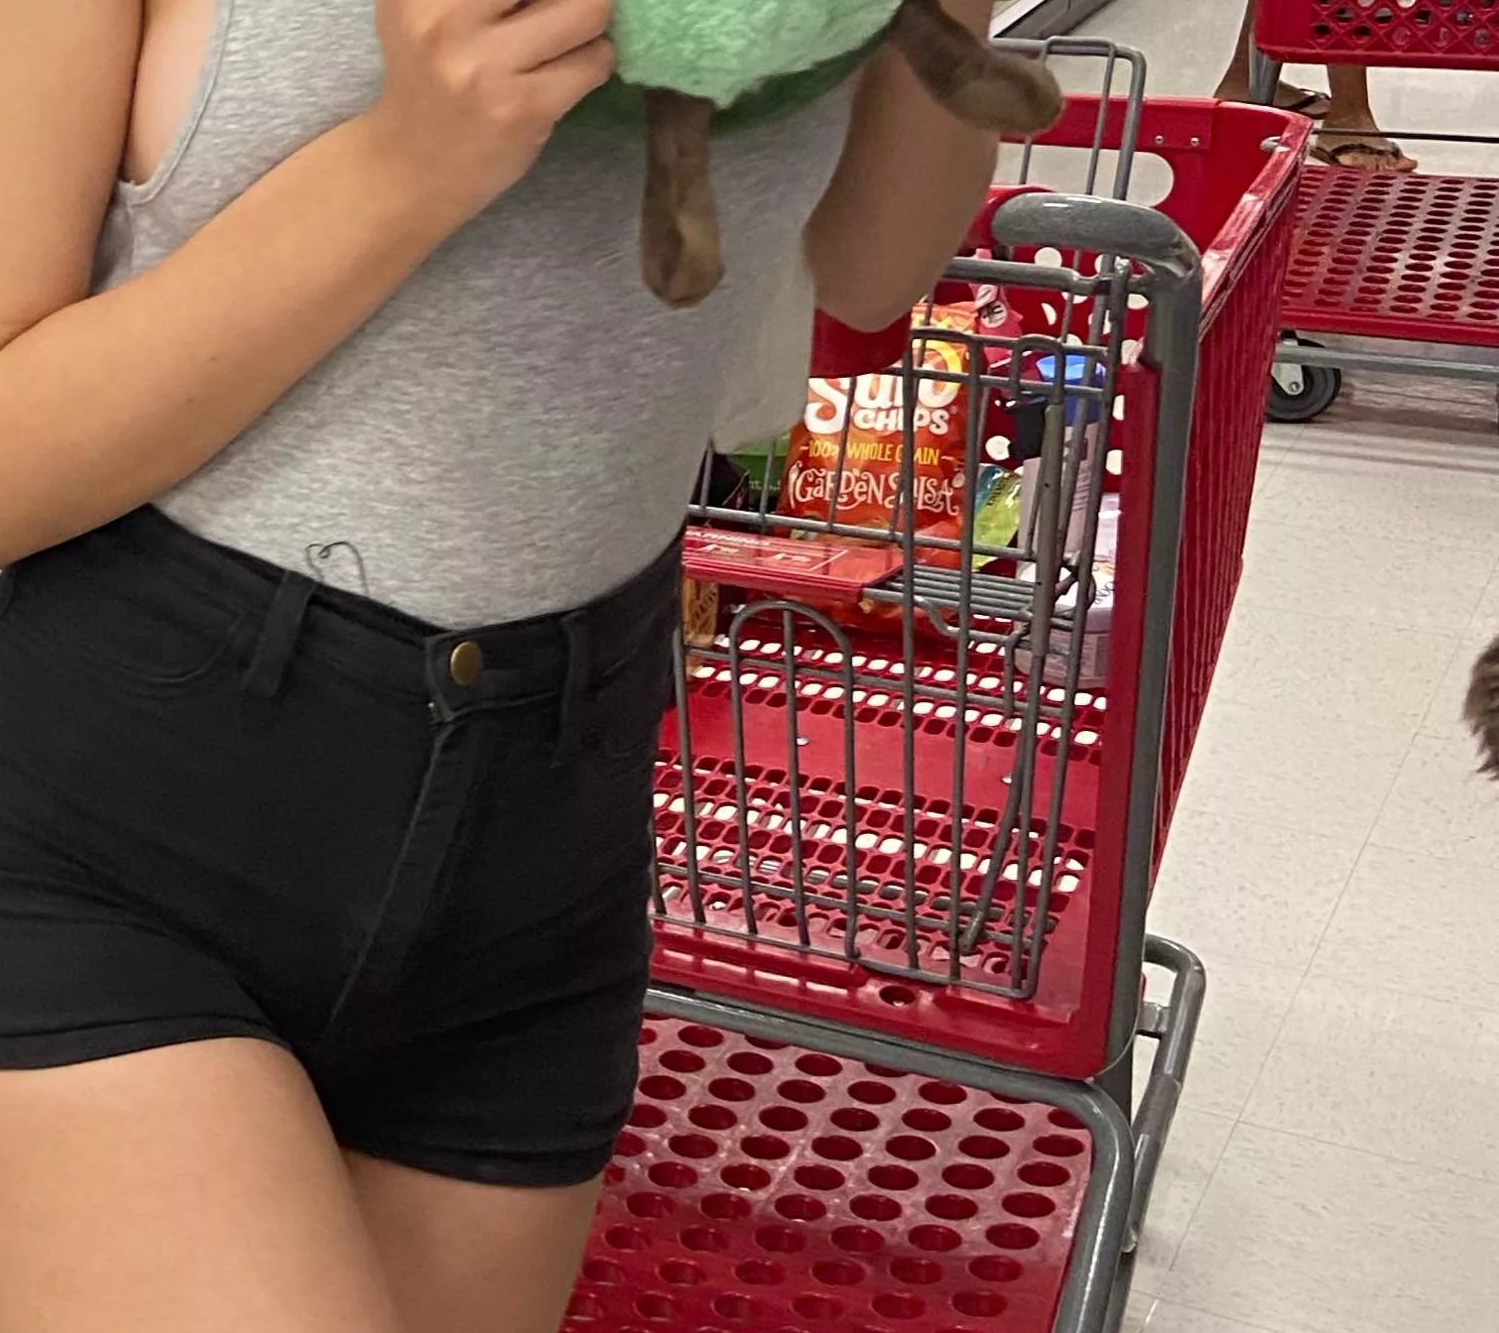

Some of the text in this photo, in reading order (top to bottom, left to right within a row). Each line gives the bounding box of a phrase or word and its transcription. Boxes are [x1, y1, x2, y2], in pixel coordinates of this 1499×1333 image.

[853, 407, 950, 436] CHPS
[846, 442, 894, 462] WHOLE
[895, 444, 940, 466] GAIN
